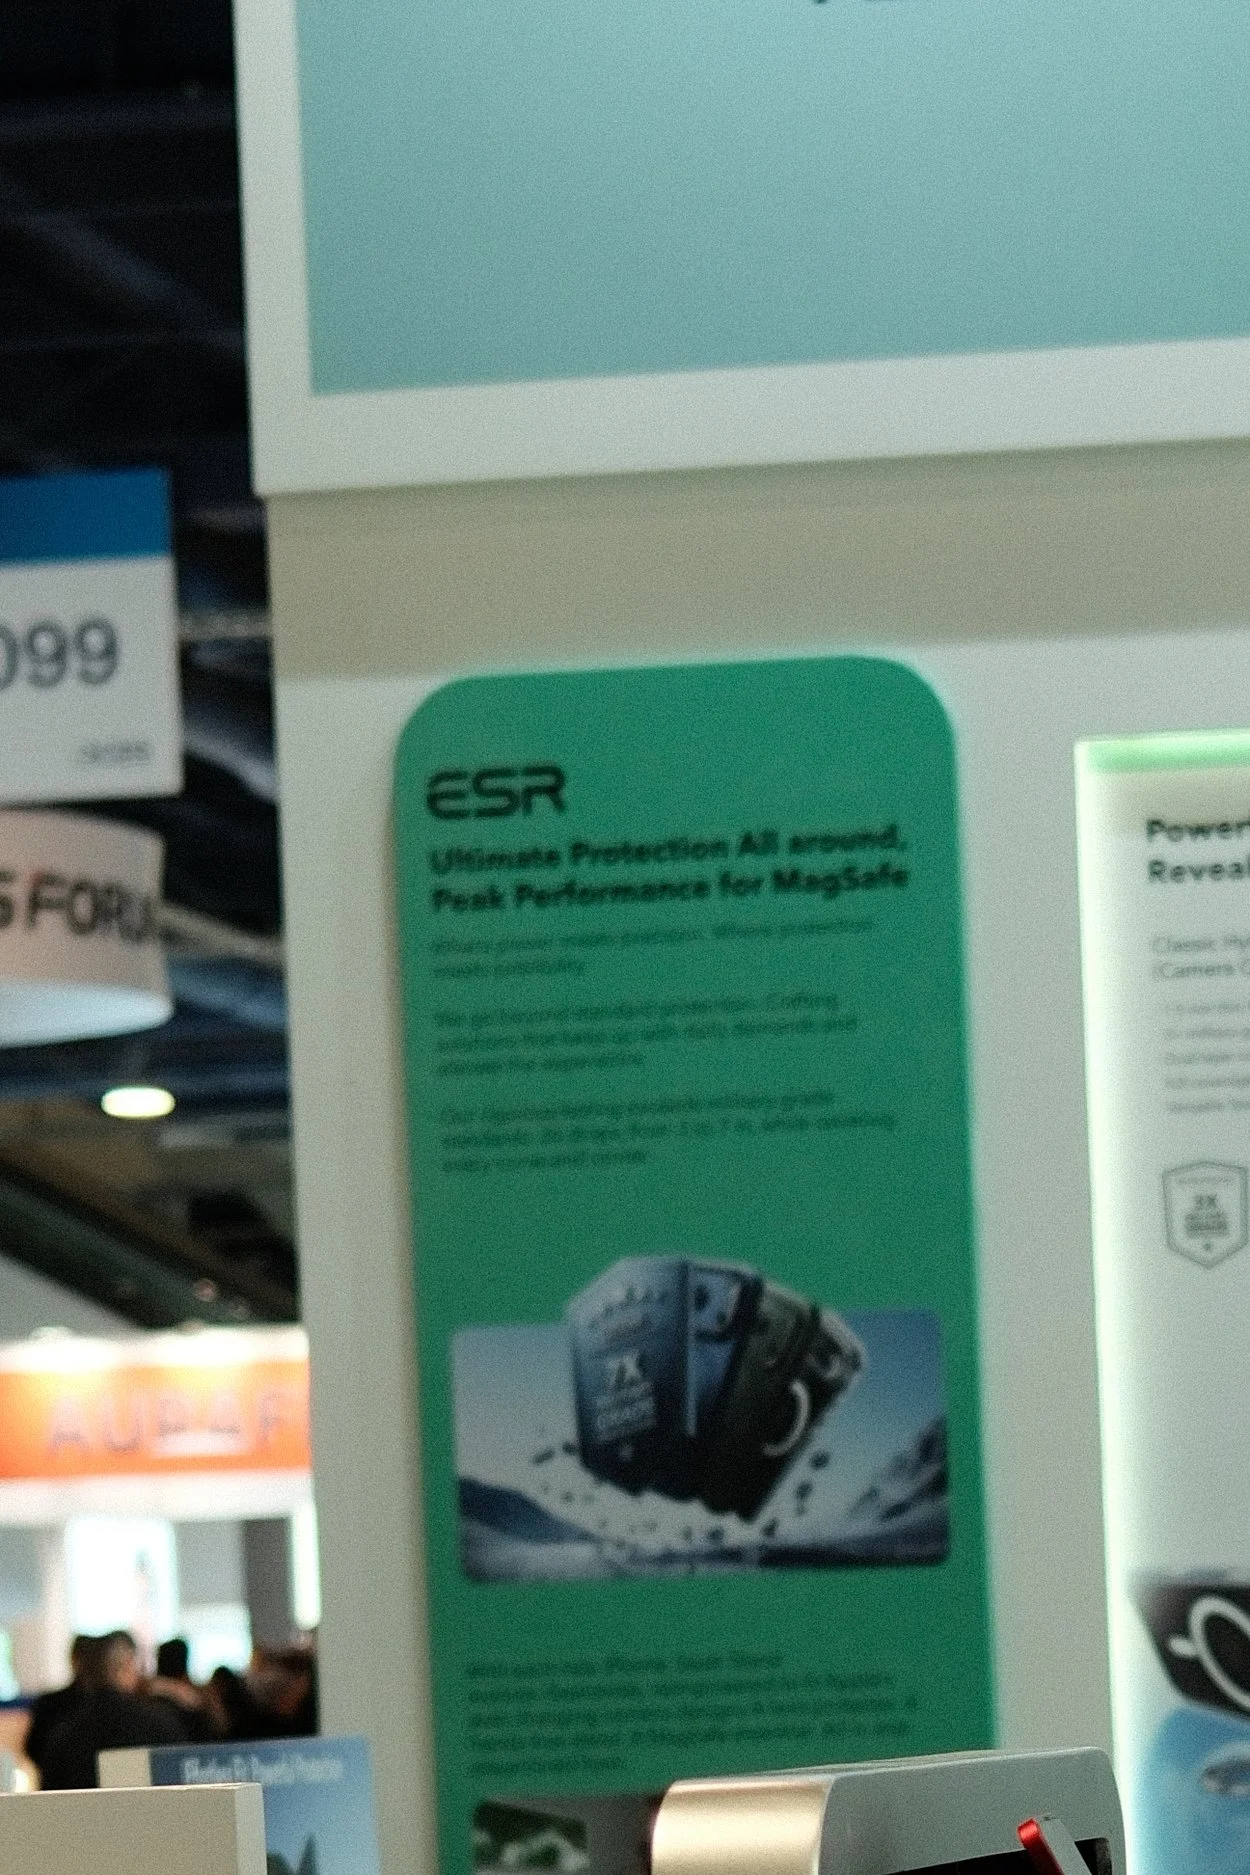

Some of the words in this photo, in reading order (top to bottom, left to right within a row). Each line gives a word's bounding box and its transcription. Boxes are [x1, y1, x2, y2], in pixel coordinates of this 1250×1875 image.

[426, 763, 566, 819] ESR
[431, 847, 560, 875] Ultimate
[570, 836, 729, 867] Protection
[738, 828, 779, 856] All
[432, 885, 503, 912] Peak
[516, 878, 710, 908] Performance
[719, 869, 764, 897] for
[772, 862, 909, 899] MagSafe
